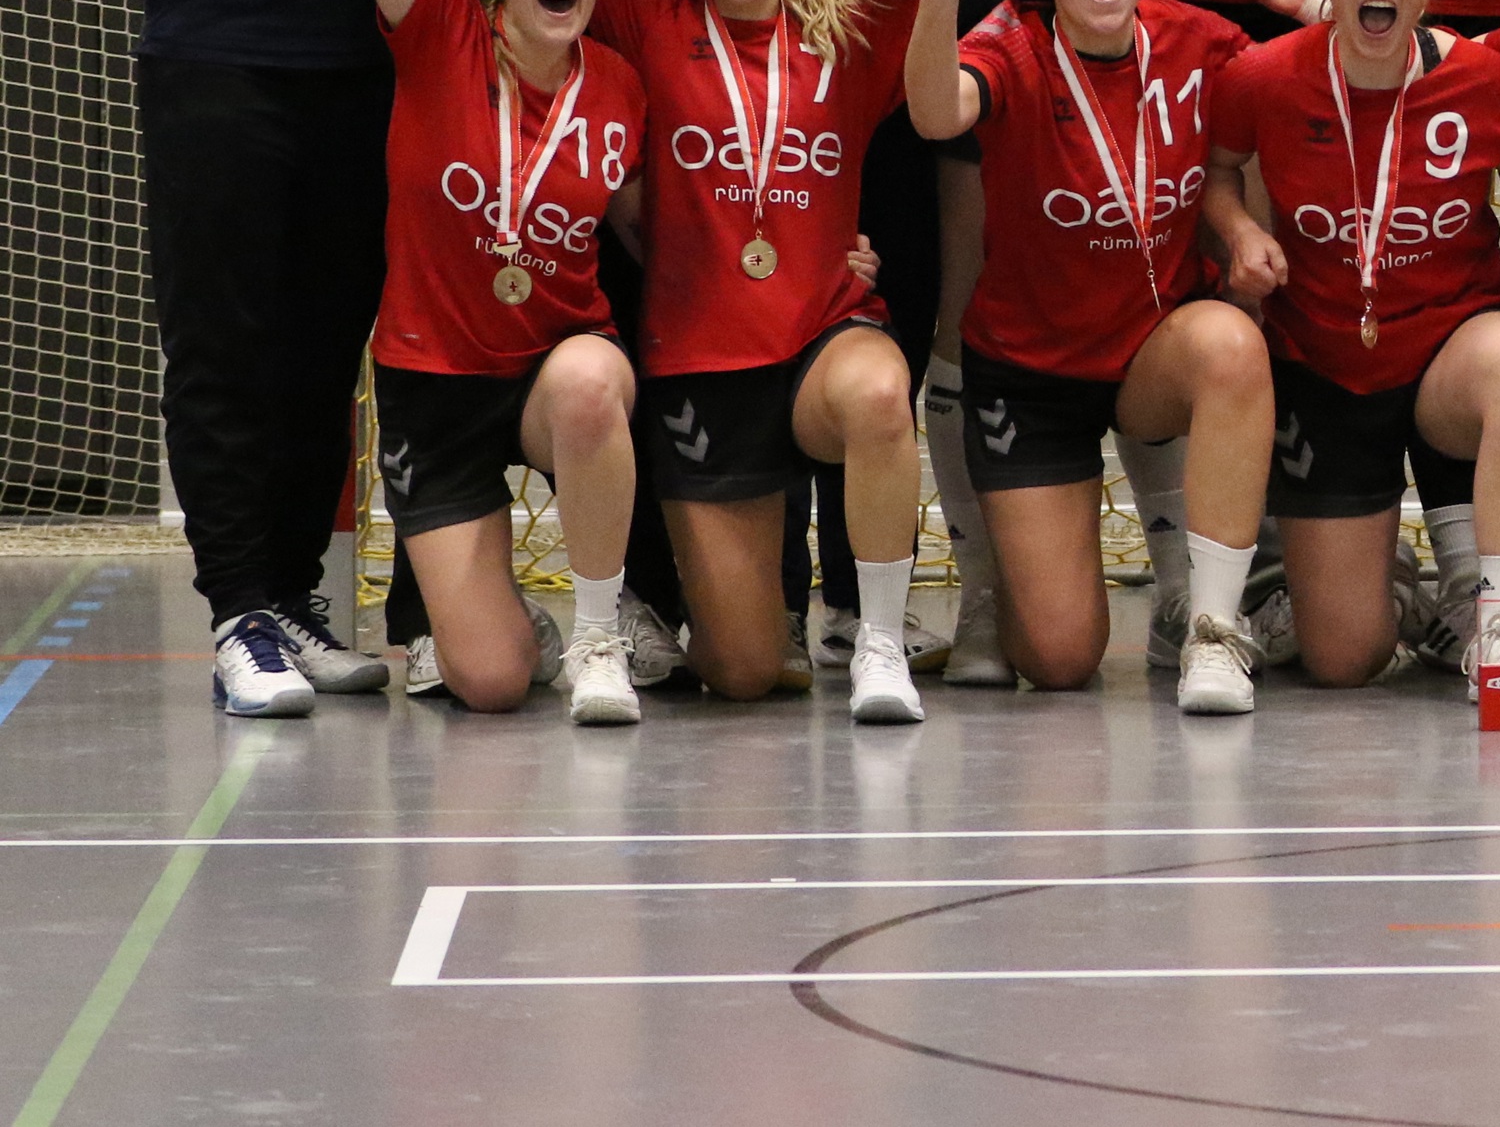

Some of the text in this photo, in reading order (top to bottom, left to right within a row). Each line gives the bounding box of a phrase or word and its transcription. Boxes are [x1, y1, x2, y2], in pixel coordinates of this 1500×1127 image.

[799, 42, 836, 103] 7
[1137, 68, 1202, 146] 11
[560, 116, 627, 191] 18
[671, 124, 843, 177] oase
[1425, 111, 1469, 179] 9
[714, 184, 810, 210] rümang
[1294, 198, 1471, 244] oase
